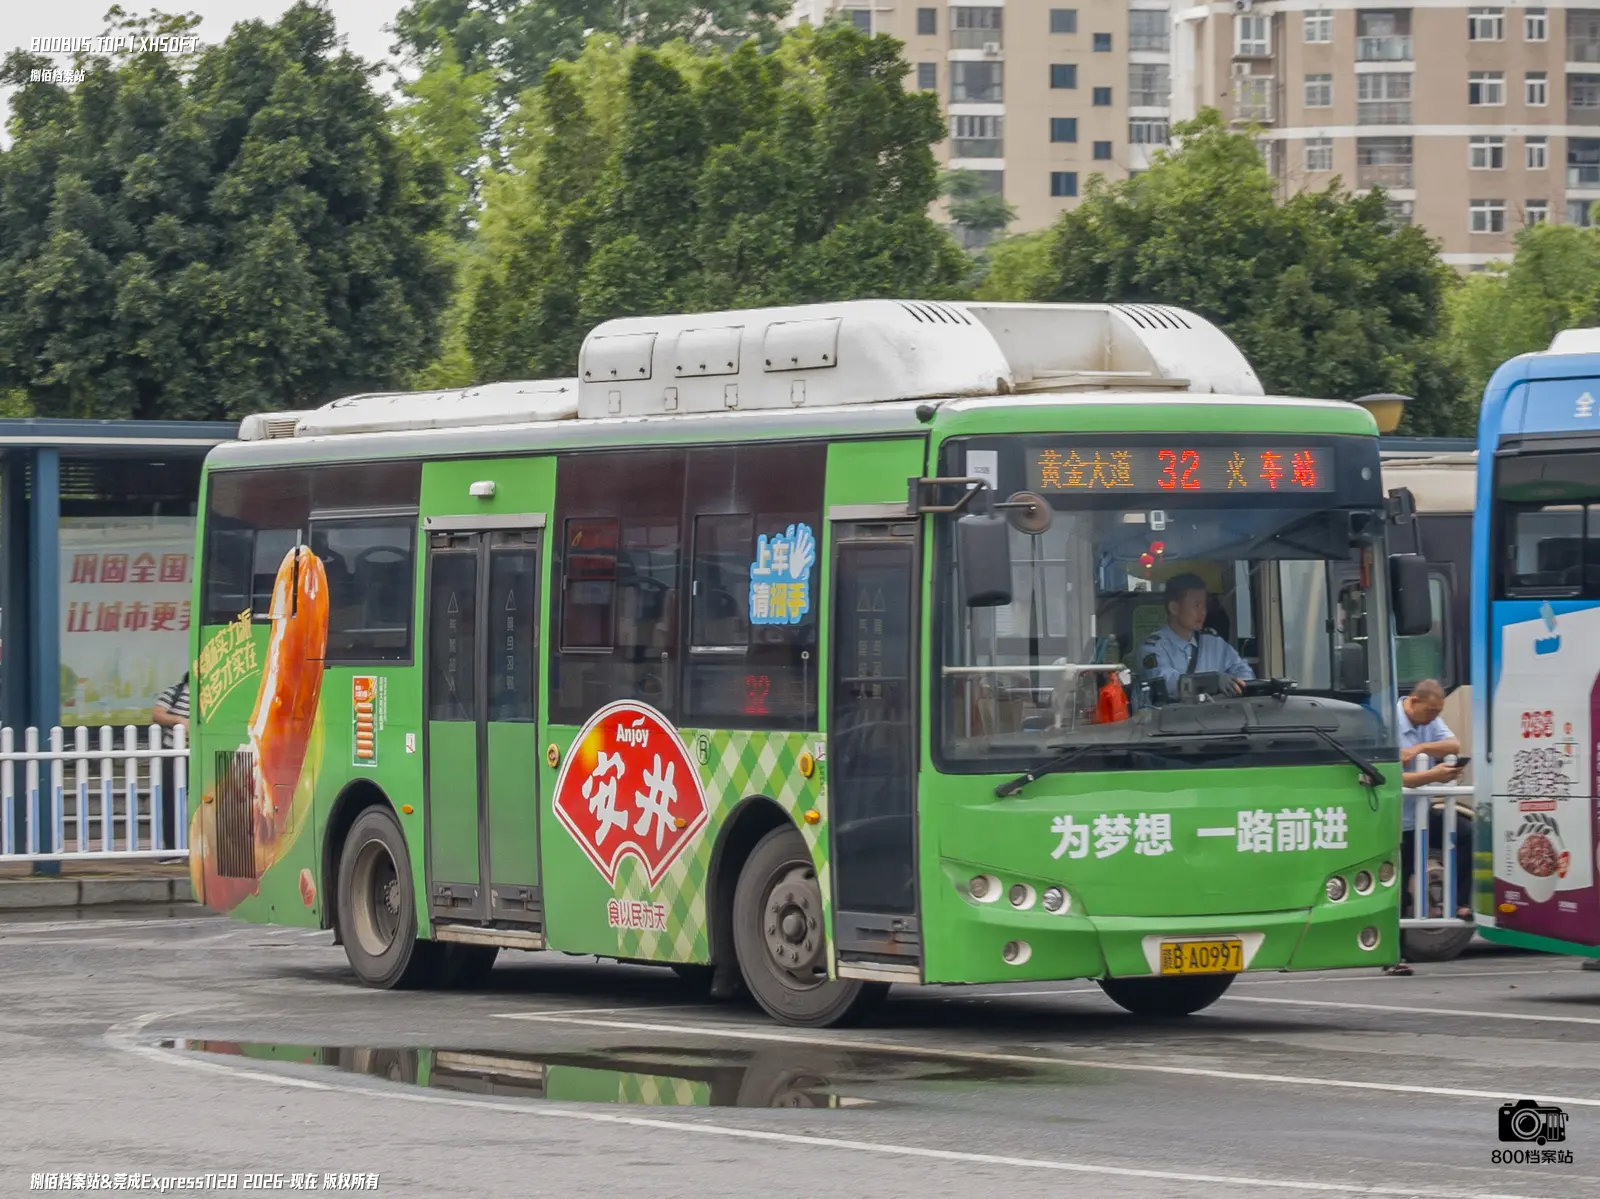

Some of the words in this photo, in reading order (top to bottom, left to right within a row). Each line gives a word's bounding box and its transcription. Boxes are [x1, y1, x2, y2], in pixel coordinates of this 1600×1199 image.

[1038, 449, 1134, 488] 黄金大道
[1157, 450, 1200, 488] 32
[1226, 450, 1315, 488] 火车站
[69, 552, 193, 584] 巩固全国
[753, 540, 789, 577] 上车
[752, 582, 806, 618] 请招手
[616, 717, 649, 748] Anjoy
[582, 751, 677, 851] 安井
[1050, 813, 1173, 860] 为梦想
[1197, 806, 1348, 853] 一路前进
[608, 900, 667, 931] 食以民为天
